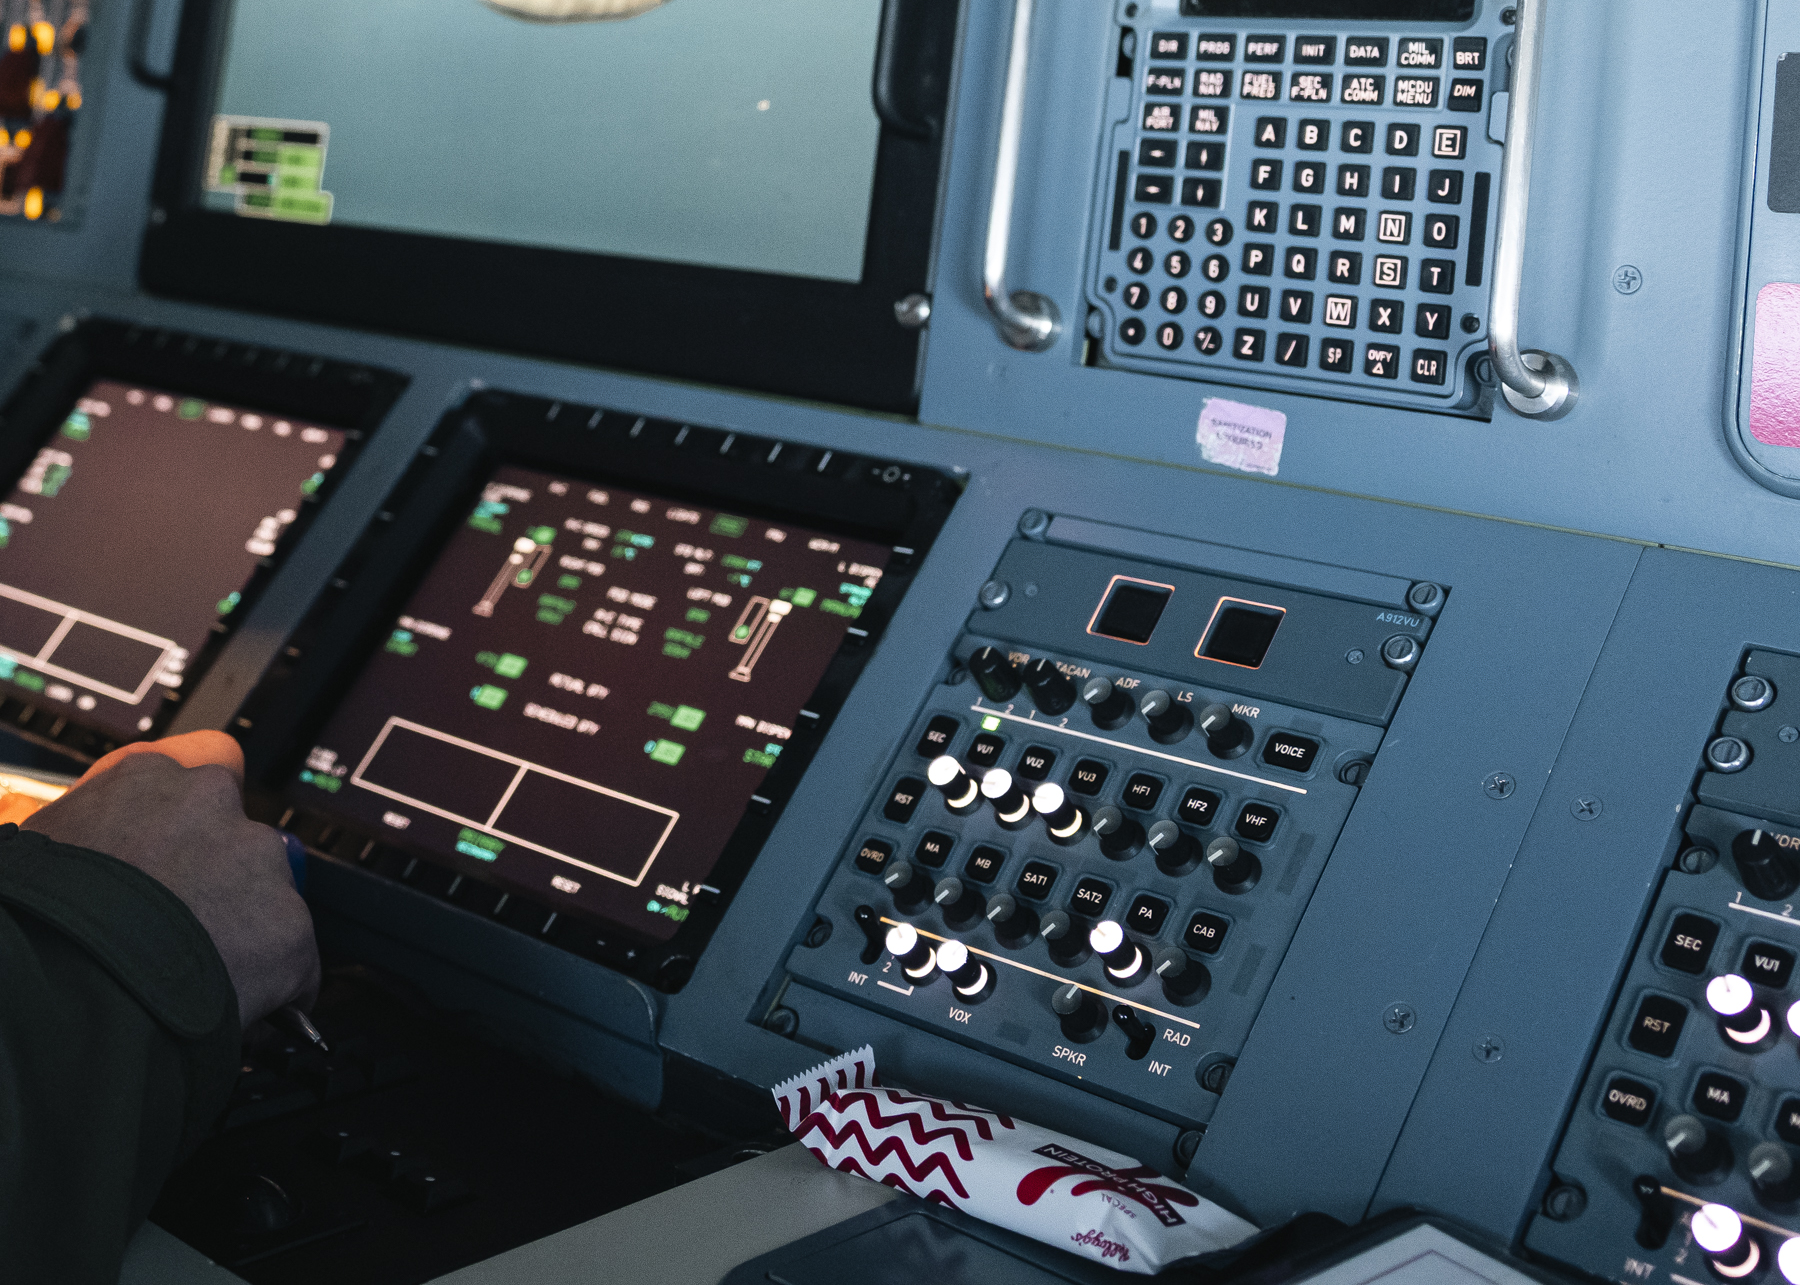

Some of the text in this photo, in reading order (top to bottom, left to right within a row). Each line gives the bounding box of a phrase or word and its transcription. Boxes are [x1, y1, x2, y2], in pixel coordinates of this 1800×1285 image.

[1247, 42, 1279, 56] PERF
[1301, 44, 1326, 58] INIT
[1349, 45, 1380, 59] DATA
[1408, 41, 1429, 54] MIL
[1400, 53, 1436, 66] COMM
[1455, 51, 1480, 65] BRT
[1350, 78, 1375, 90] ATC
[1397, 80, 1433, 93] MCDU
[1453, 84, 1476, 97] DIM
[1344, 89, 1379, 102] COMM
[1396, 92, 1432, 105] MENU
[1260, 123, 1276, 143] A
[1304, 125, 1319, 145] B
[1349, 128, 1362, 147] C
[1394, 130, 1408, 150] D
[1441, 133, 1455, 152] E
[1257, 165, 1272, 184] F
[1301, 168, 1314, 188] G
[1344, 171, 1359, 191] H
[1393, 174, 1400, 194] I
[1437, 178, 1450, 197] J
[1139, 217, 1147, 235] 1
[1253, 208, 1268, 227] K
[1296, 210, 1308, 230] L
[1339, 214, 1356, 234] M
[1174, 219, 1186, 239] 2
[1212, 223, 1223, 242] 3
[1386, 219, 1400, 237] N
[1432, 222, 1447, 241] O
[1170, 255, 1181, 274] 5
[1249, 249, 1263, 268] P
[1291, 253, 1305, 273] Q
[1208, 259, 1220, 278] 6
[1336, 258, 1350, 278] R
[1382, 263, 1395, 281] S
[1430, 267, 1441, 286] T
[1130, 286, 1141, 305] 7
[1166, 291, 1178, 310] 8
[1245, 292, 1259, 311] U
[1205, 295, 1216, 315] 9
[1289, 297, 1302, 316] V
[1330, 303, 1348, 321] W
[1377, 307, 1392, 326] X
[1426, 311, 1439, 331] Y
[1162, 327, 1174, 346] 0
[1240, 335, 1255, 355] Z
[1327, 347, 1342, 364] SP
[1368, 349, 1392, 363] OVFY
[1417, 359, 1437, 376] CLR
[1376, 612, 1420, 628] A912VU
[1008, 651, 1030, 664] VOR
[1055, 661, 1091, 679] TACAN
[1115, 677, 1141, 689] ADF
[1177, 691, 1194, 703] LS
[1232, 703, 1260, 719] MKR
[927, 730, 947, 744] SEC
[976, 743, 994, 755] VU1
[1274, 742, 1306, 758] VOICE
[1026, 756, 1045, 769] VU2
[1077, 770, 1097, 782] VU3
[894, 792, 914, 805] RST
[1132, 784, 1151, 797] HF1
[1187, 798, 1208, 812] HF2
[1245, 814, 1268, 827] VHF
[860, 848, 885, 863] OVRD
[925, 841, 940, 854] MA
[975, 857, 992, 869] MB
[1023, 872, 1048, 886] SAT1
[1076, 888, 1103, 904] SAT2
[1138, 906, 1153, 919] PA
[1193, 924, 1216, 938] CAB
[1674, 934, 1702, 951] SEC
[1754, 954, 1780, 972] VU1
[848, 971, 869, 986] INT
[949, 1006, 972, 1025] VOX
[1643, 1016, 1671, 1034] RST
[1163, 1028, 1191, 1047] RAD
[1052, 1045, 1087, 1067] SPKR
[1148, 1060, 1172, 1077] INT
[1609, 1089, 1647, 1111] OVRD
[1707, 1086, 1730, 1105] MA
[1043, 1147, 1178, 1224] HIGH PROTEIN
[1100, 1193, 1137, 1220] SPECAL
[1071, 1229, 1130, 1262] Kellogg's
